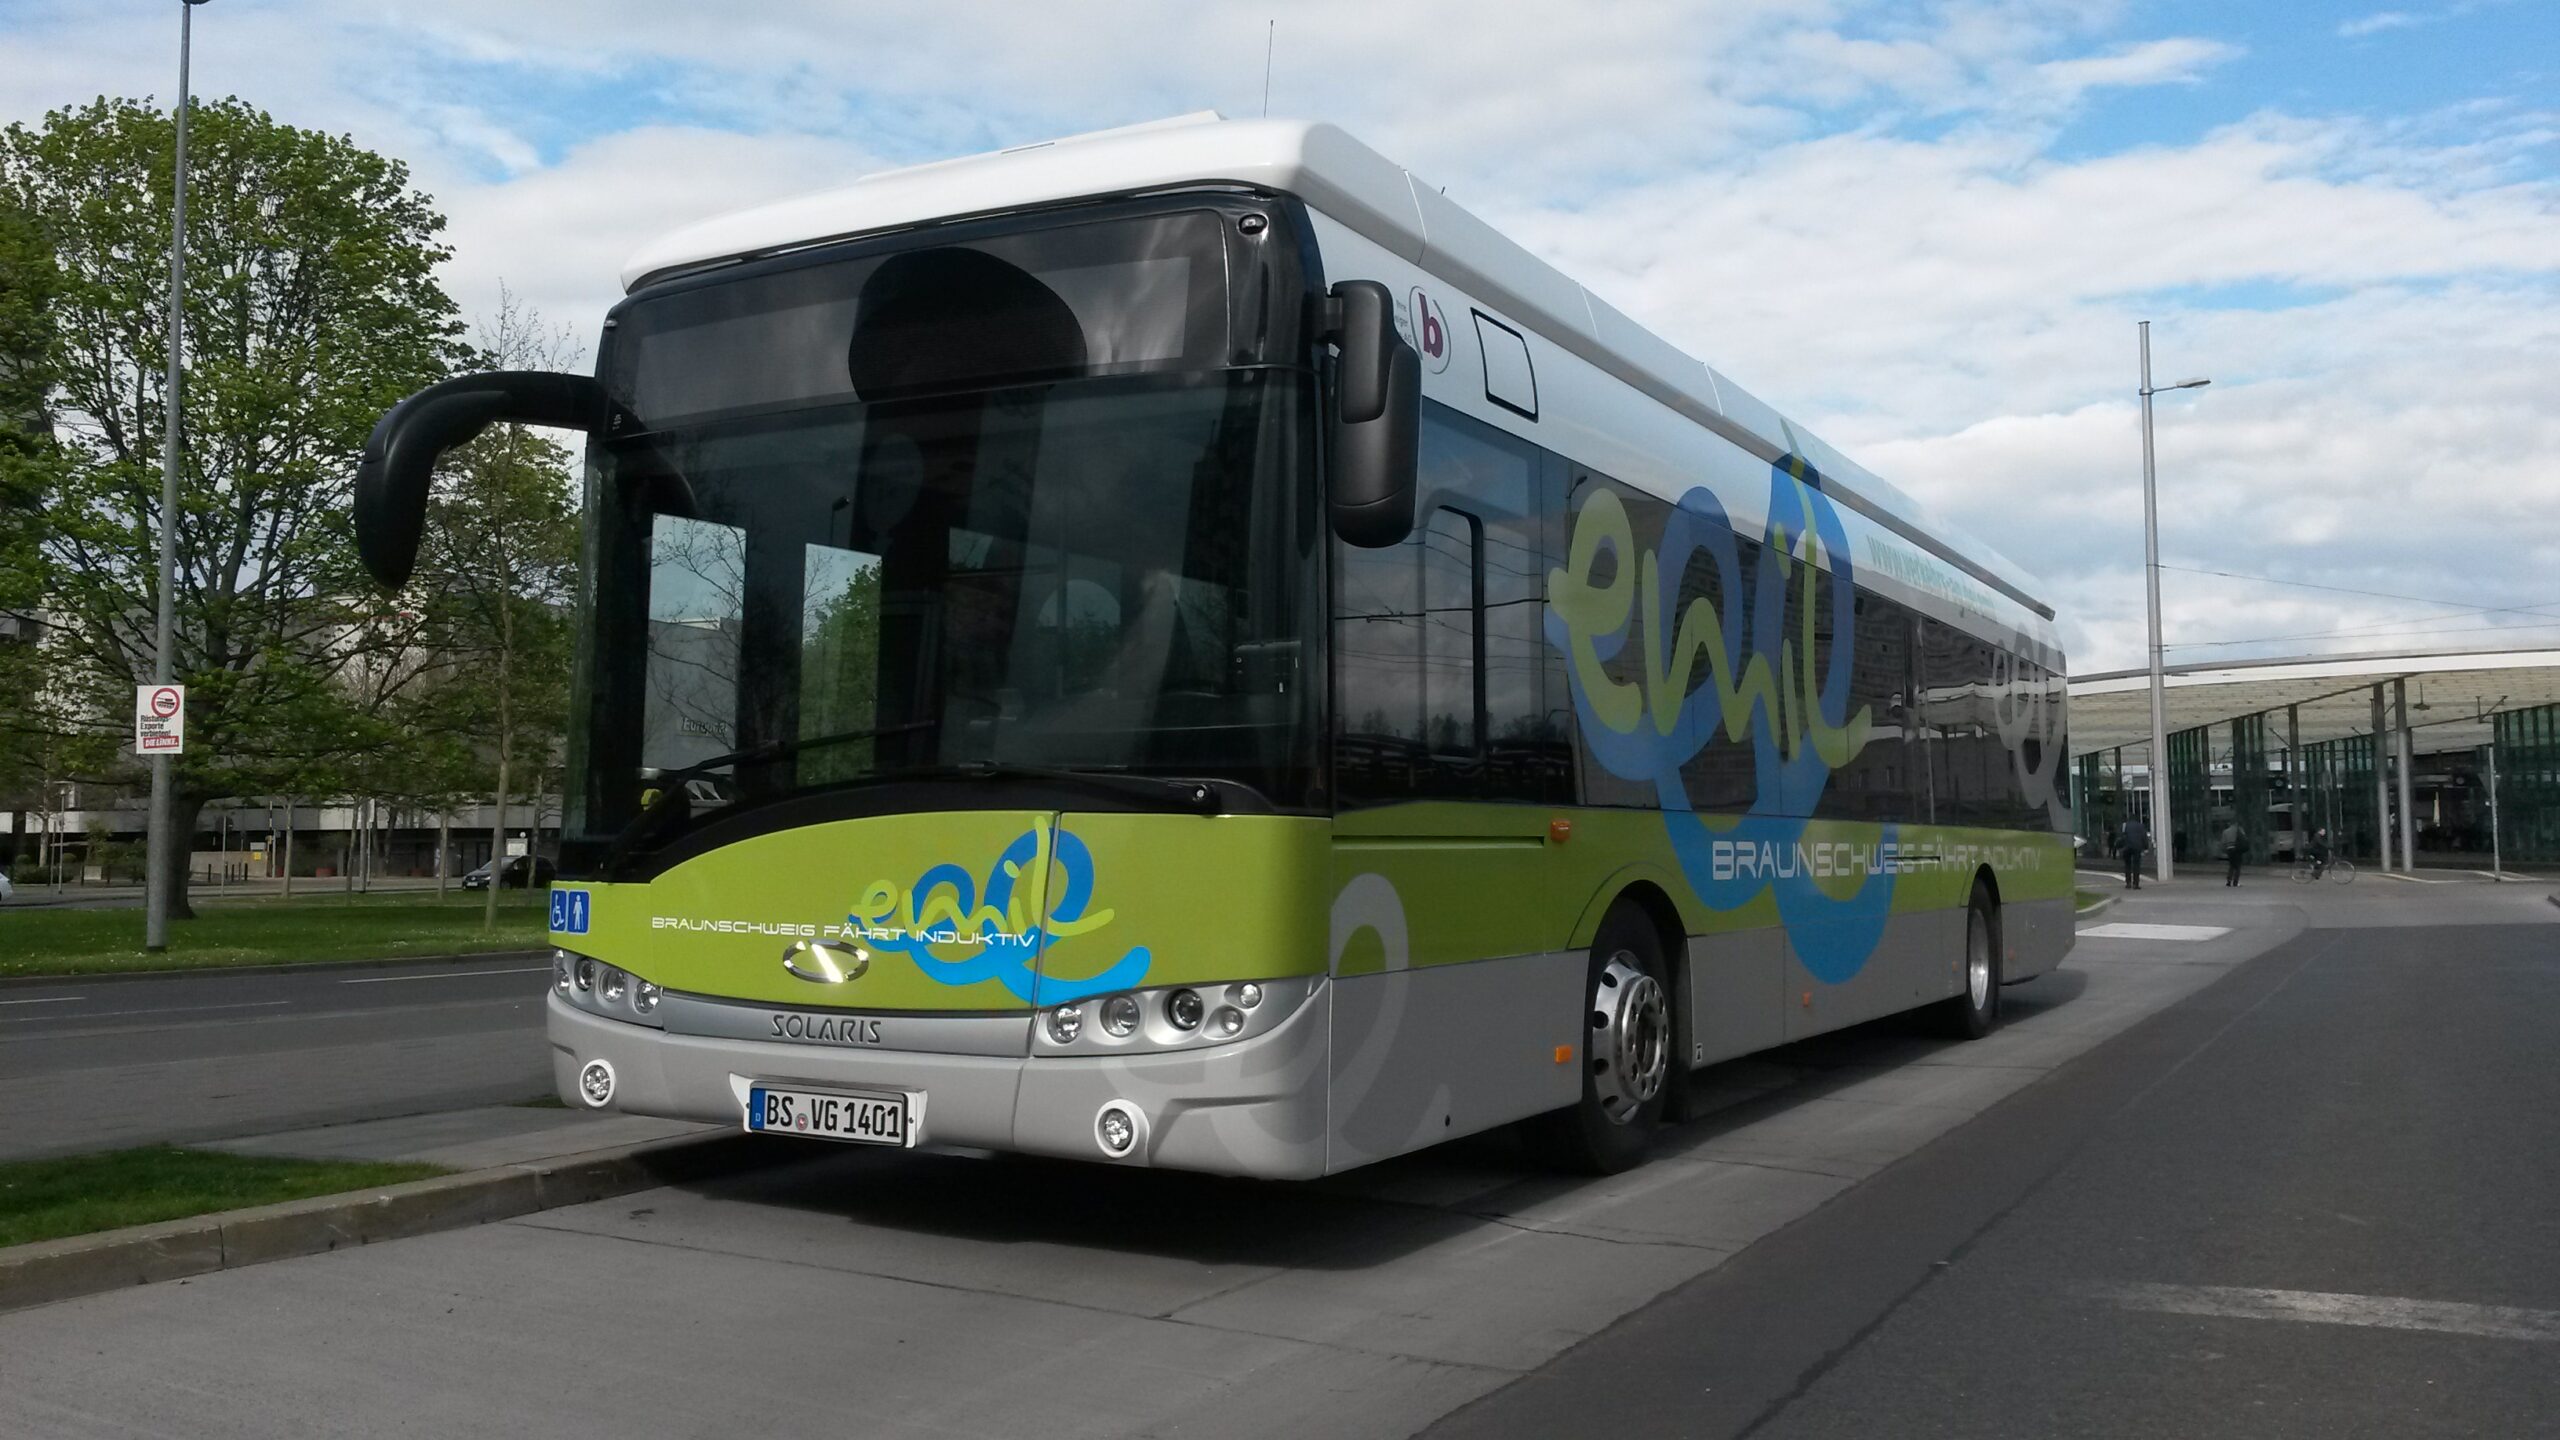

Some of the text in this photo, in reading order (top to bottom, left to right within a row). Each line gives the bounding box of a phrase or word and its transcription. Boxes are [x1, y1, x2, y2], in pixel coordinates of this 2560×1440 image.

[145, 739, 156, 747] DIE
[1712, 839, 1915, 881] BRAUNSCHWEIG
[1920, 833, 1979, 872] FÄHRT
[851, 816, 1115, 936] emil
[652, 916, 1036, 948] BRAUNSCHWEIG FÄHRT INDUKTIV
[770, 1013, 883, 1044] SOLARIS
[754, 1112, 762, 1122] D
[765, 1094, 900, 1138] BS VG 1401
